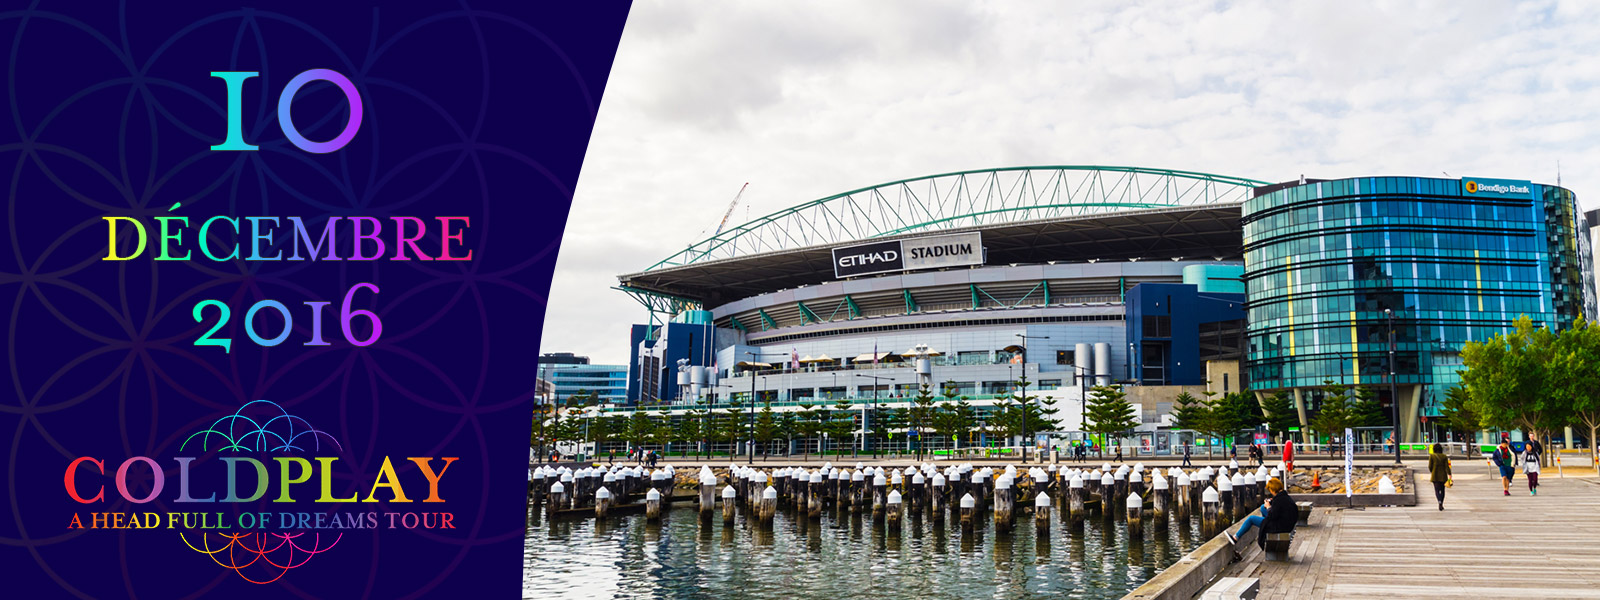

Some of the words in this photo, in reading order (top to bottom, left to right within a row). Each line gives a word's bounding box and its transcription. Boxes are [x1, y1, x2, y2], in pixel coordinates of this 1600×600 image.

[1478, 183, 1509, 194] Bendigo
[1509, 184, 1530, 194] Bank
[838, 250, 898, 268] ETIHAD
[911, 243, 973, 260] STADIUM
